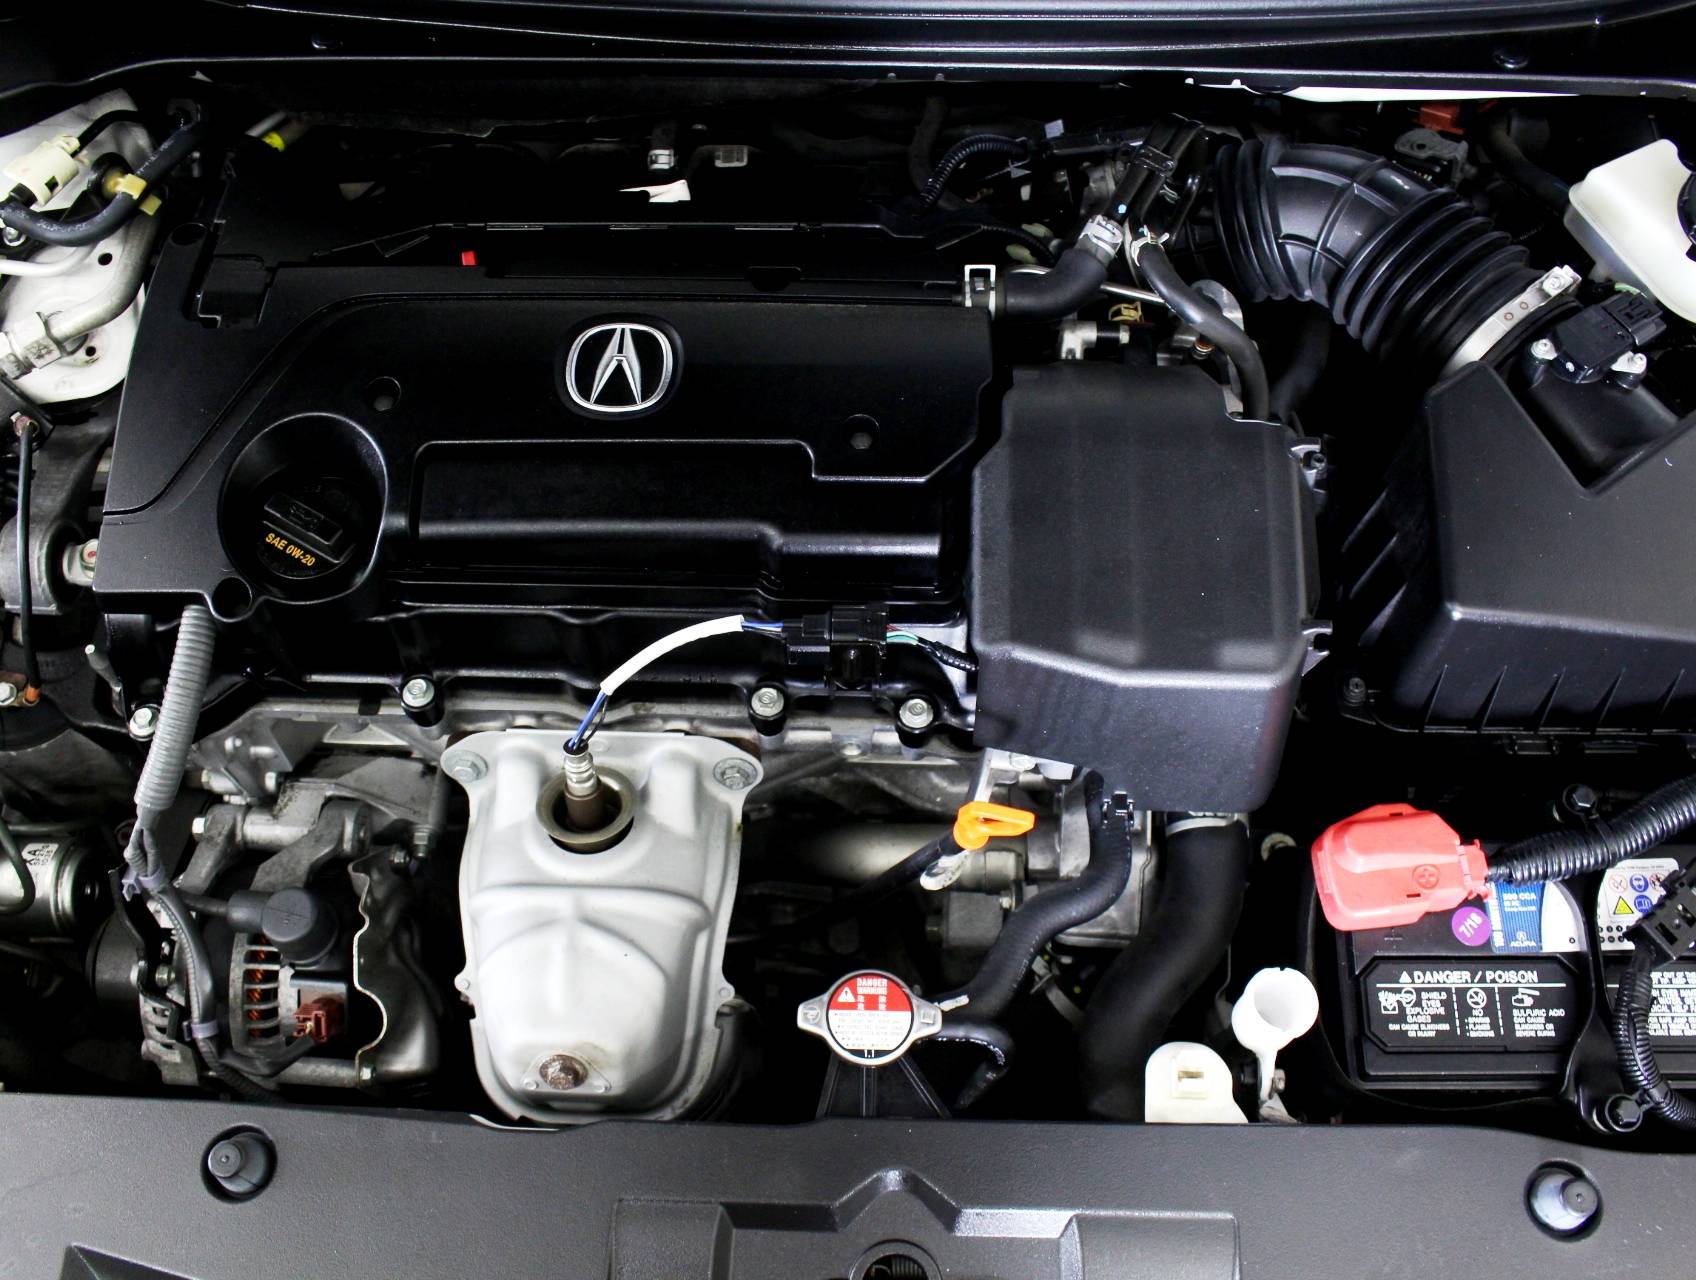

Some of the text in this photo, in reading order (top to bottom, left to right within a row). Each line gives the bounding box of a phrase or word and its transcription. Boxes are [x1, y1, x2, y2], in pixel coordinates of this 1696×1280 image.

[265, 532, 316, 567] SAE 0W-20
[1413, 970, 1471, 984] DANGER
[1485, 970, 1538, 983] POISON
[856, 977, 888, 987] DANGER
[856, 987, 888, 995] WARNING
[1421, 991, 1447, 1000] SHIELD
[1405, 1007, 1445, 1015] EXPLOSIVE
[1512, 1009, 1547, 1017] SULFURIC
[1406, 1015, 1431, 1023] GASES
[863, 1049, 875, 1058] 1.1
